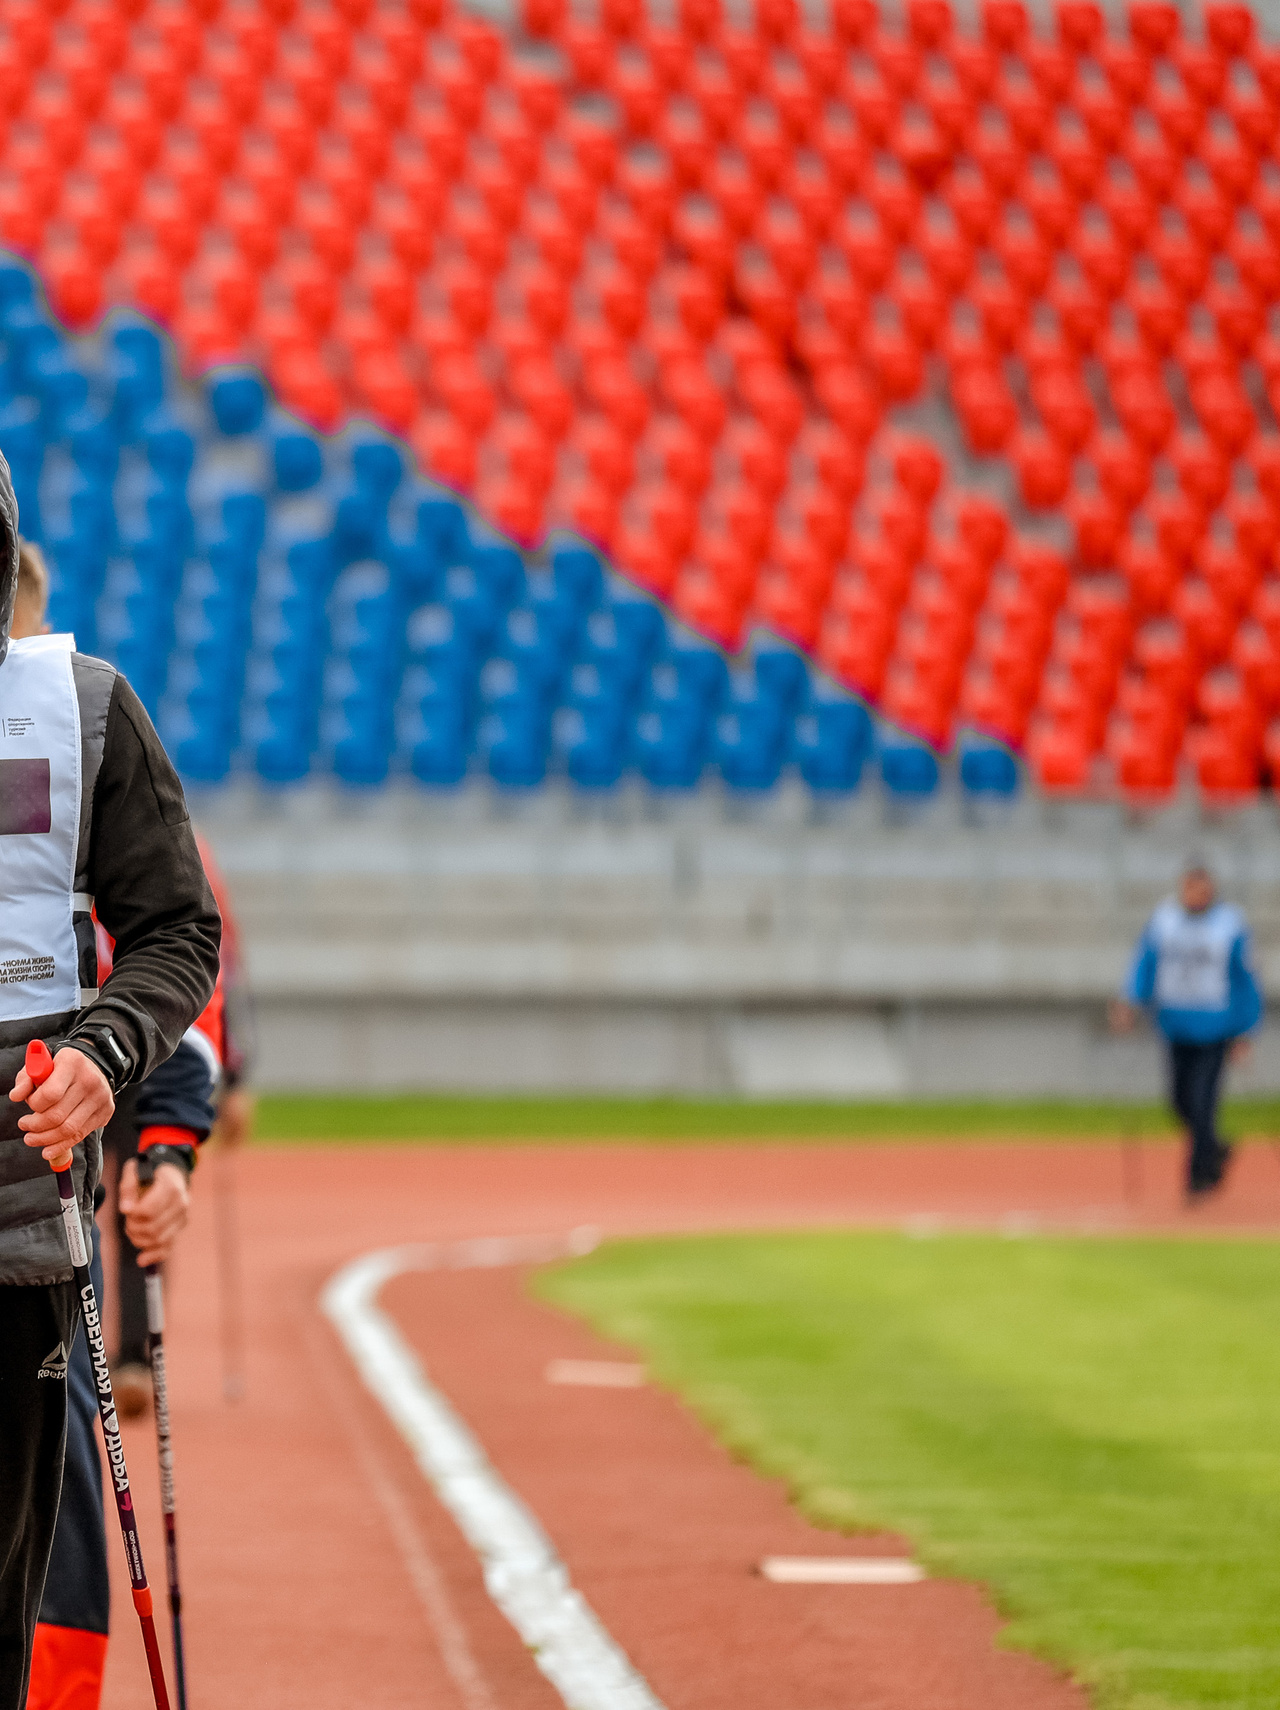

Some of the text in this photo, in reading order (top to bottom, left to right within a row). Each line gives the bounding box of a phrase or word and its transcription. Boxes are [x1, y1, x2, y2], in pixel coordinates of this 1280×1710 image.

[32, 956, 54, 964] ЖИЗНИ
[8, 966, 31, 975] ЖИЗНИ
[80, 1283, 112, 1394] СЕВЕРНАЯ
[37, 1369, 67, 1380] Reeb
